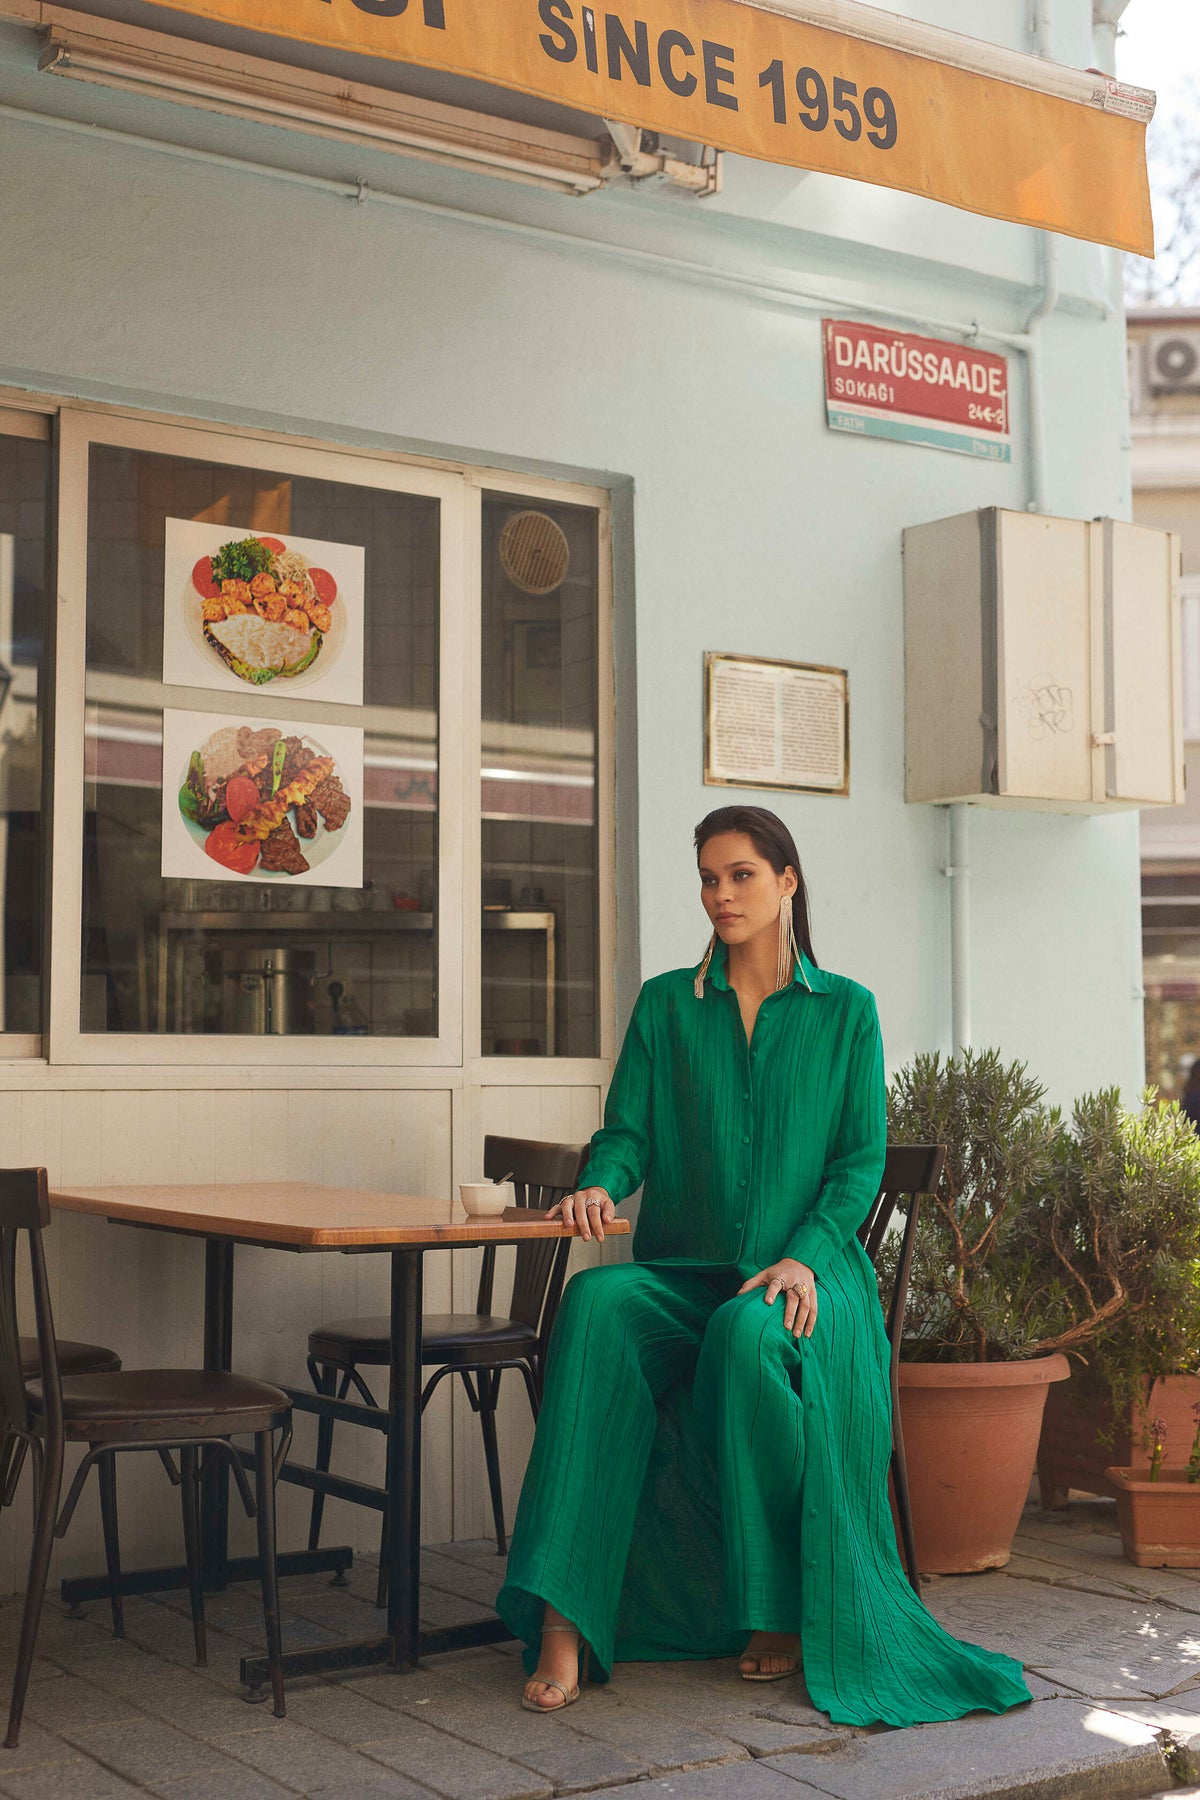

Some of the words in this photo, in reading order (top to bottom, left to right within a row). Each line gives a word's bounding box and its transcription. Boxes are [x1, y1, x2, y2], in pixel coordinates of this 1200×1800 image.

[538, 0, 739, 112] SINCE
[758, 59, 897, 150] 1959
[834, 335, 1003, 398] DARÜSSAADE
[834, 377, 895, 403] SOKAĞI
